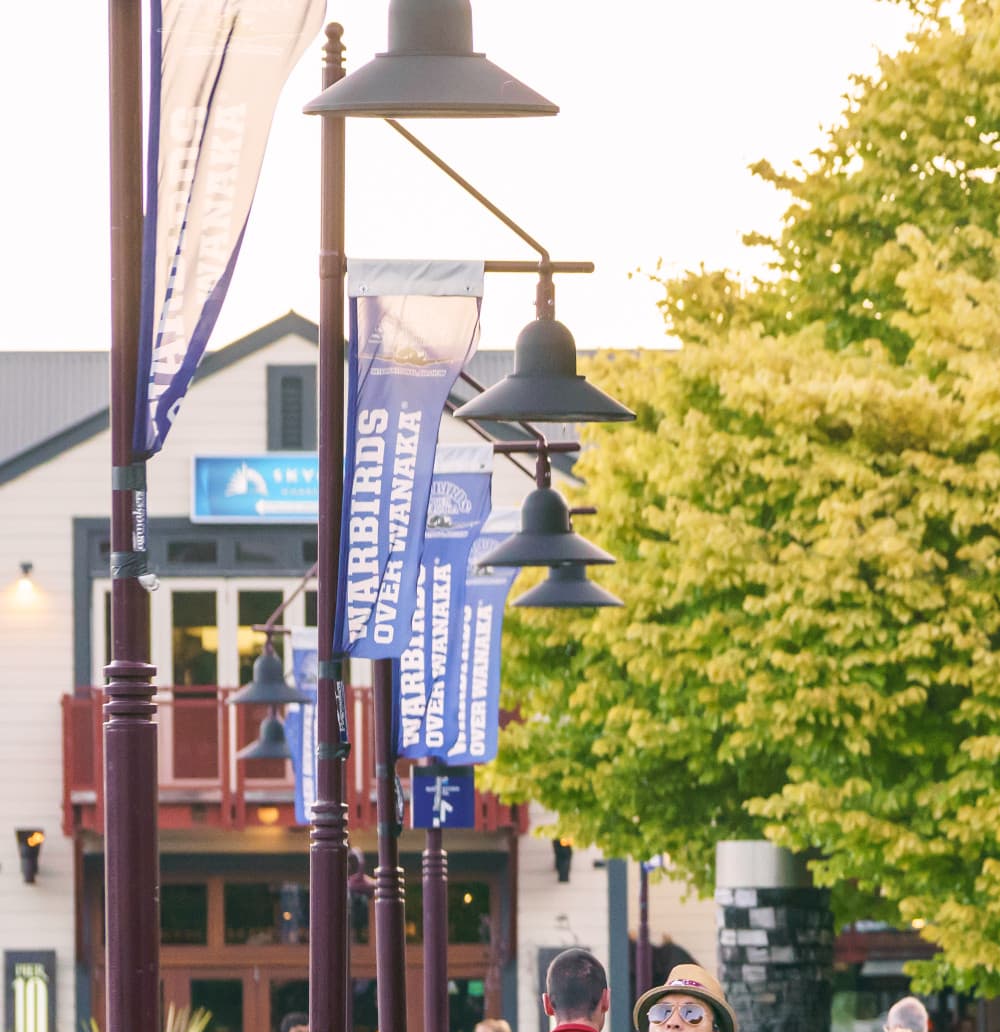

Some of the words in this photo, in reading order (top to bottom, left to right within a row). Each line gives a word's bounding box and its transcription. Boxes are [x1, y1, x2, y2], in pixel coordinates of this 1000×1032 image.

[347, 407, 389, 643] WARBIRDS
[388, 409, 422, 552] WANAKA
[374, 559, 404, 645] OVER
[431, 562, 452, 679] WANAKA
[425, 680, 445, 748] OVER
[470, 700, 487, 756] OVER
